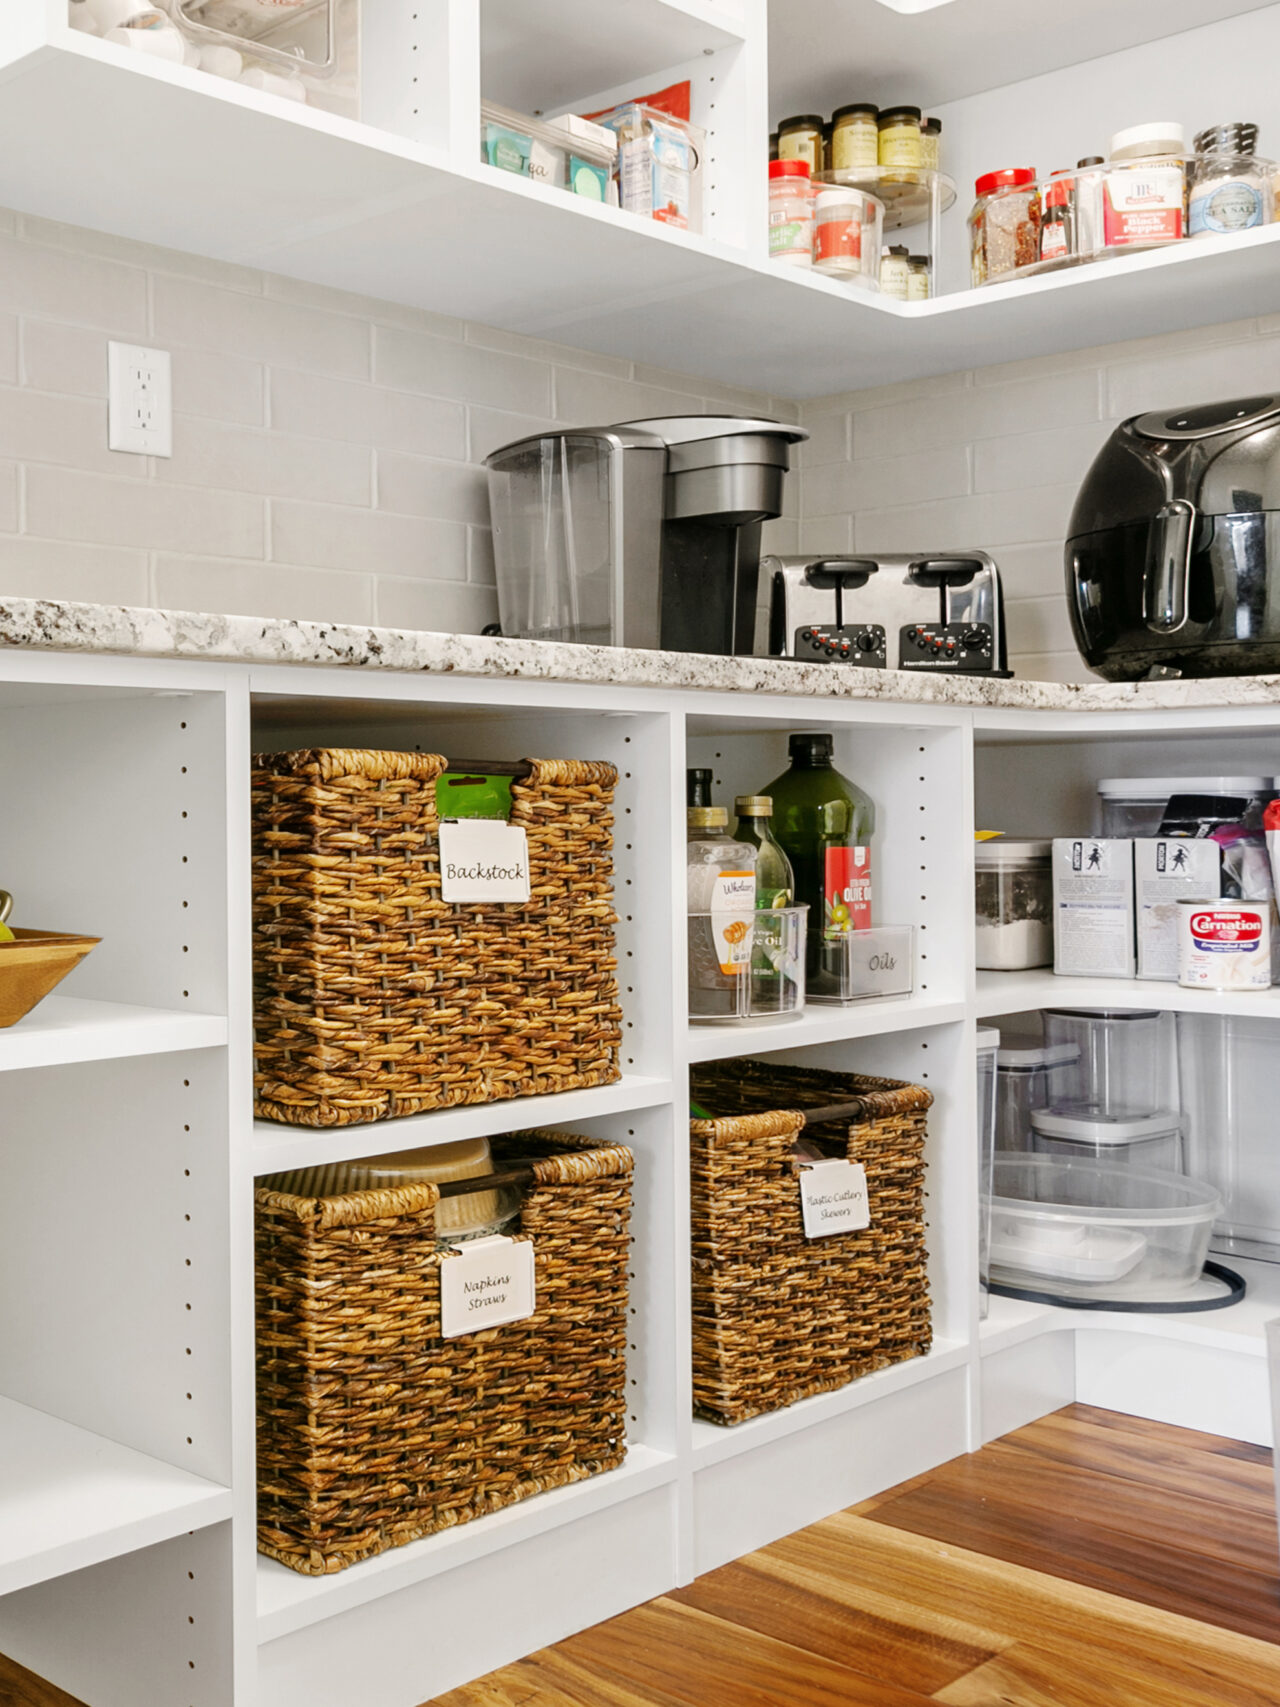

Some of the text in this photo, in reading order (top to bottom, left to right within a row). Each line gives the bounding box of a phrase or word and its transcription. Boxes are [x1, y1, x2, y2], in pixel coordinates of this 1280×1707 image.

[520, 154, 549, 177] Tea
[1123, 223, 1166, 234] Pepper
[1127, 215, 1161, 226] Black
[446, 862, 524, 881] Backstock
[1192, 915, 1262, 934] Carnation
[764, 936, 783, 946] Oil
[868, 952, 898, 972] Oils
[833, 1189, 863, 1202] Cutlery
[820, 1207, 851, 1221] Skewers
[463, 1274, 512, 1294] Napkins
[468, 1292, 508, 1312] Straws
